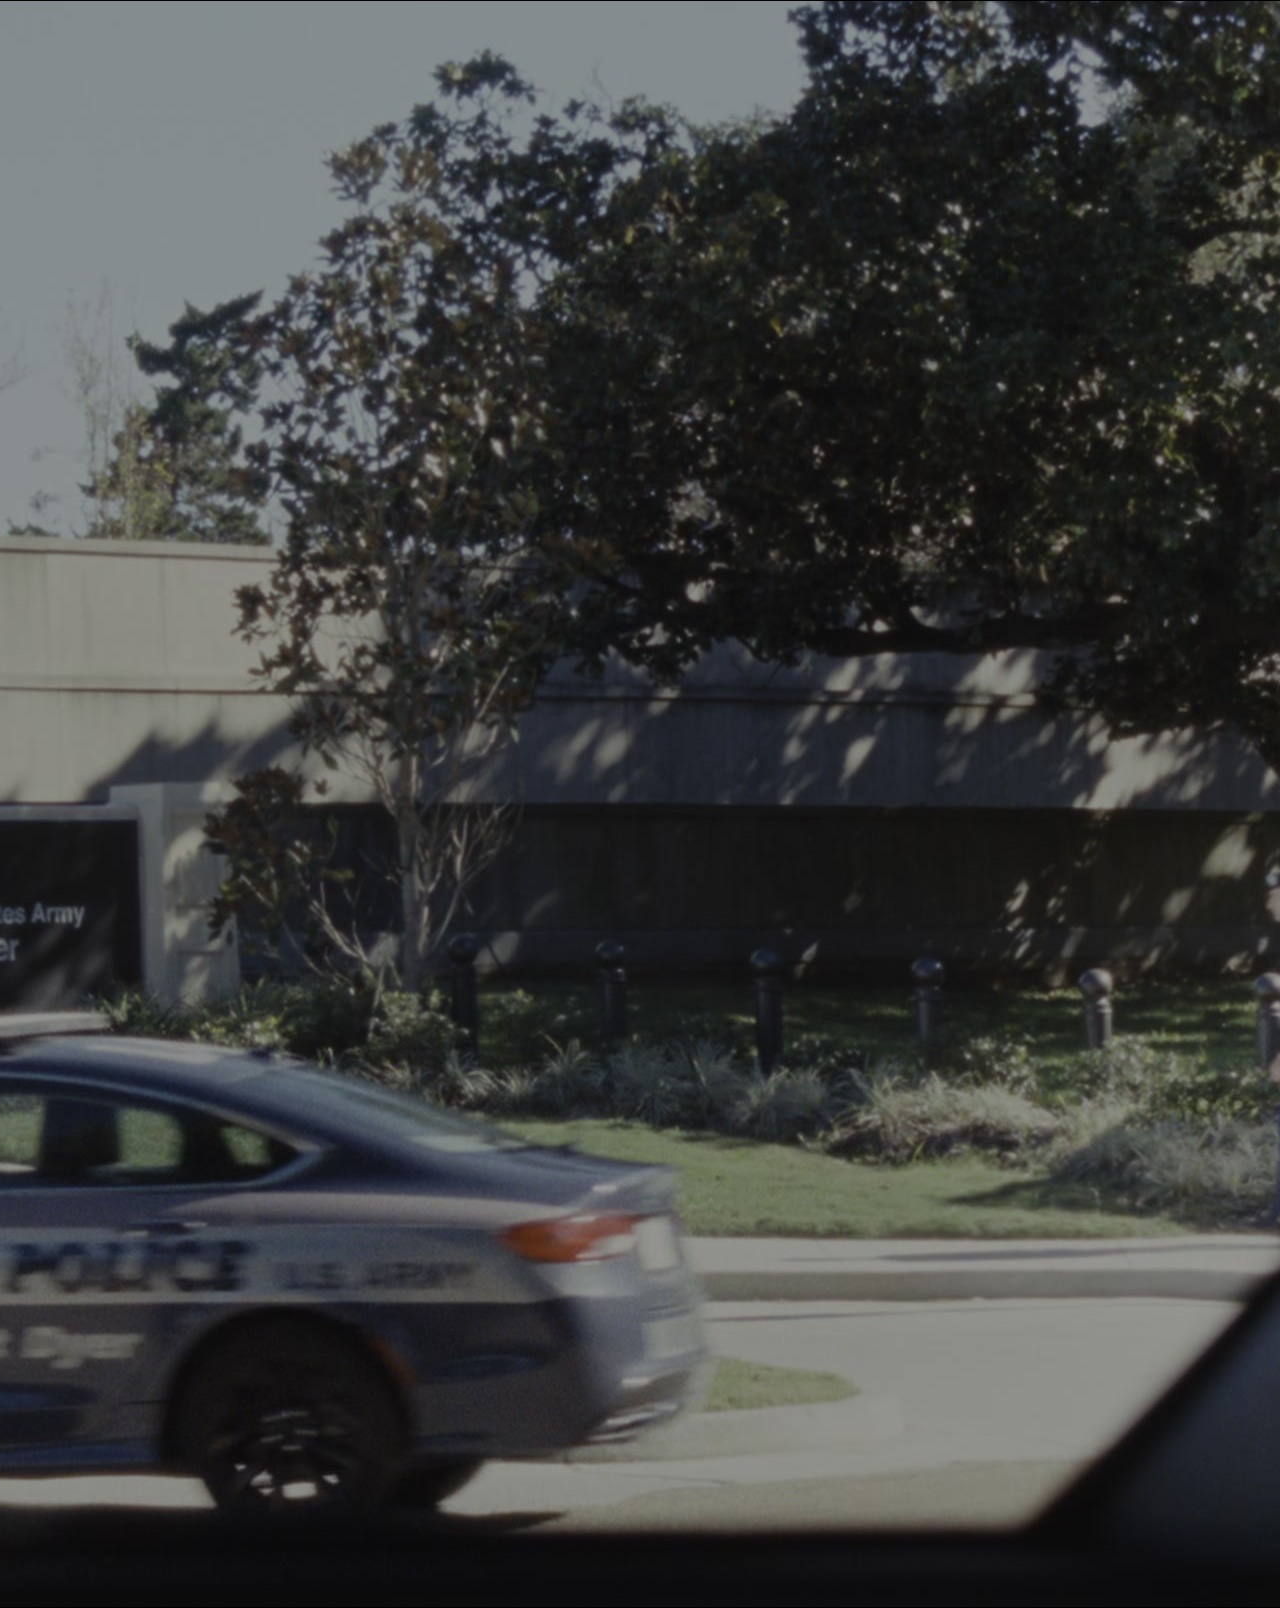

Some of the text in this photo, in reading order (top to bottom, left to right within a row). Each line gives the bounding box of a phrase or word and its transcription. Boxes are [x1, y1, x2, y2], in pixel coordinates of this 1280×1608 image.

[32, 902, 86, 929] Army
[6, 1240, 252, 1294] POLICE
[20, 1326, 144, 1369] Dyer
